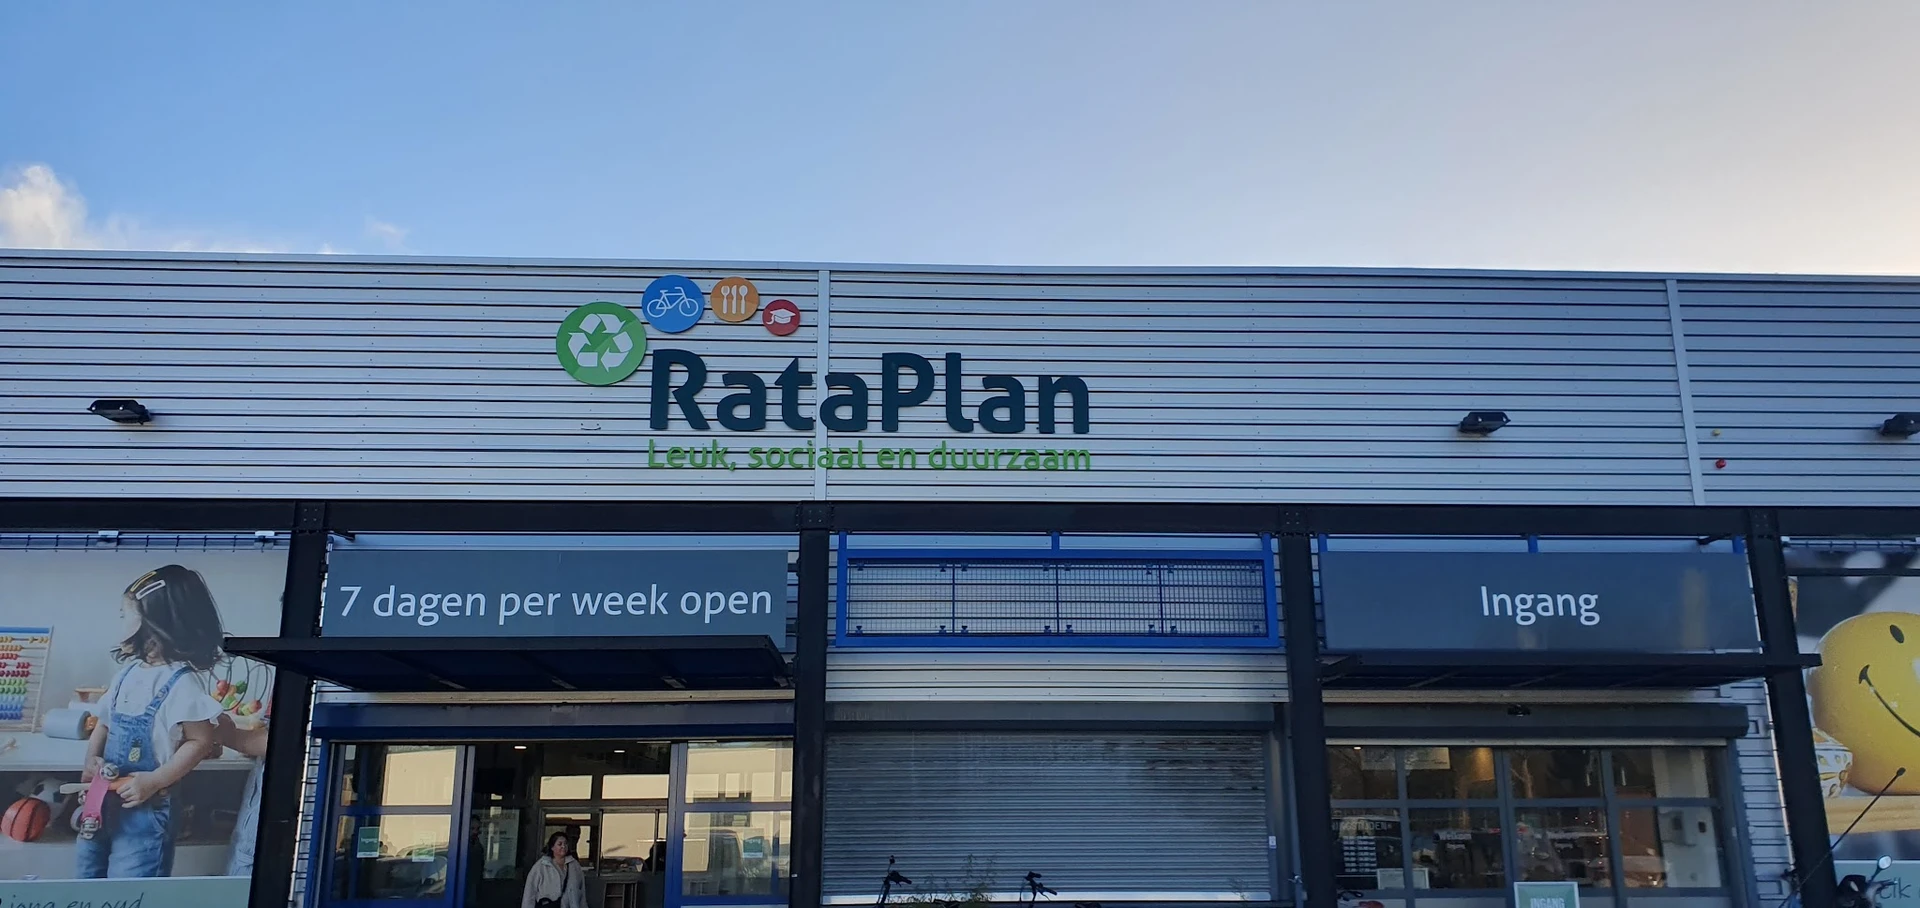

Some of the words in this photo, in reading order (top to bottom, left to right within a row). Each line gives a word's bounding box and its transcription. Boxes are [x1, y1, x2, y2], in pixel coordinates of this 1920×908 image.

[650, 348, 1090, 434] RataPlan
[648, 439, 737, 471] Leuk,
[747, 440, 866, 468] sociaal
[877, 448, 916, 469] en
[929, 440, 1091, 470] duurzaam
[340, 586, 362, 617] 7
[373, 585, 486, 626] dagen
[499, 592, 561, 625] per
[571, 583, 669, 616] week
[680, 590, 772, 624] open
[1480, 585, 1600, 626] Ingang
